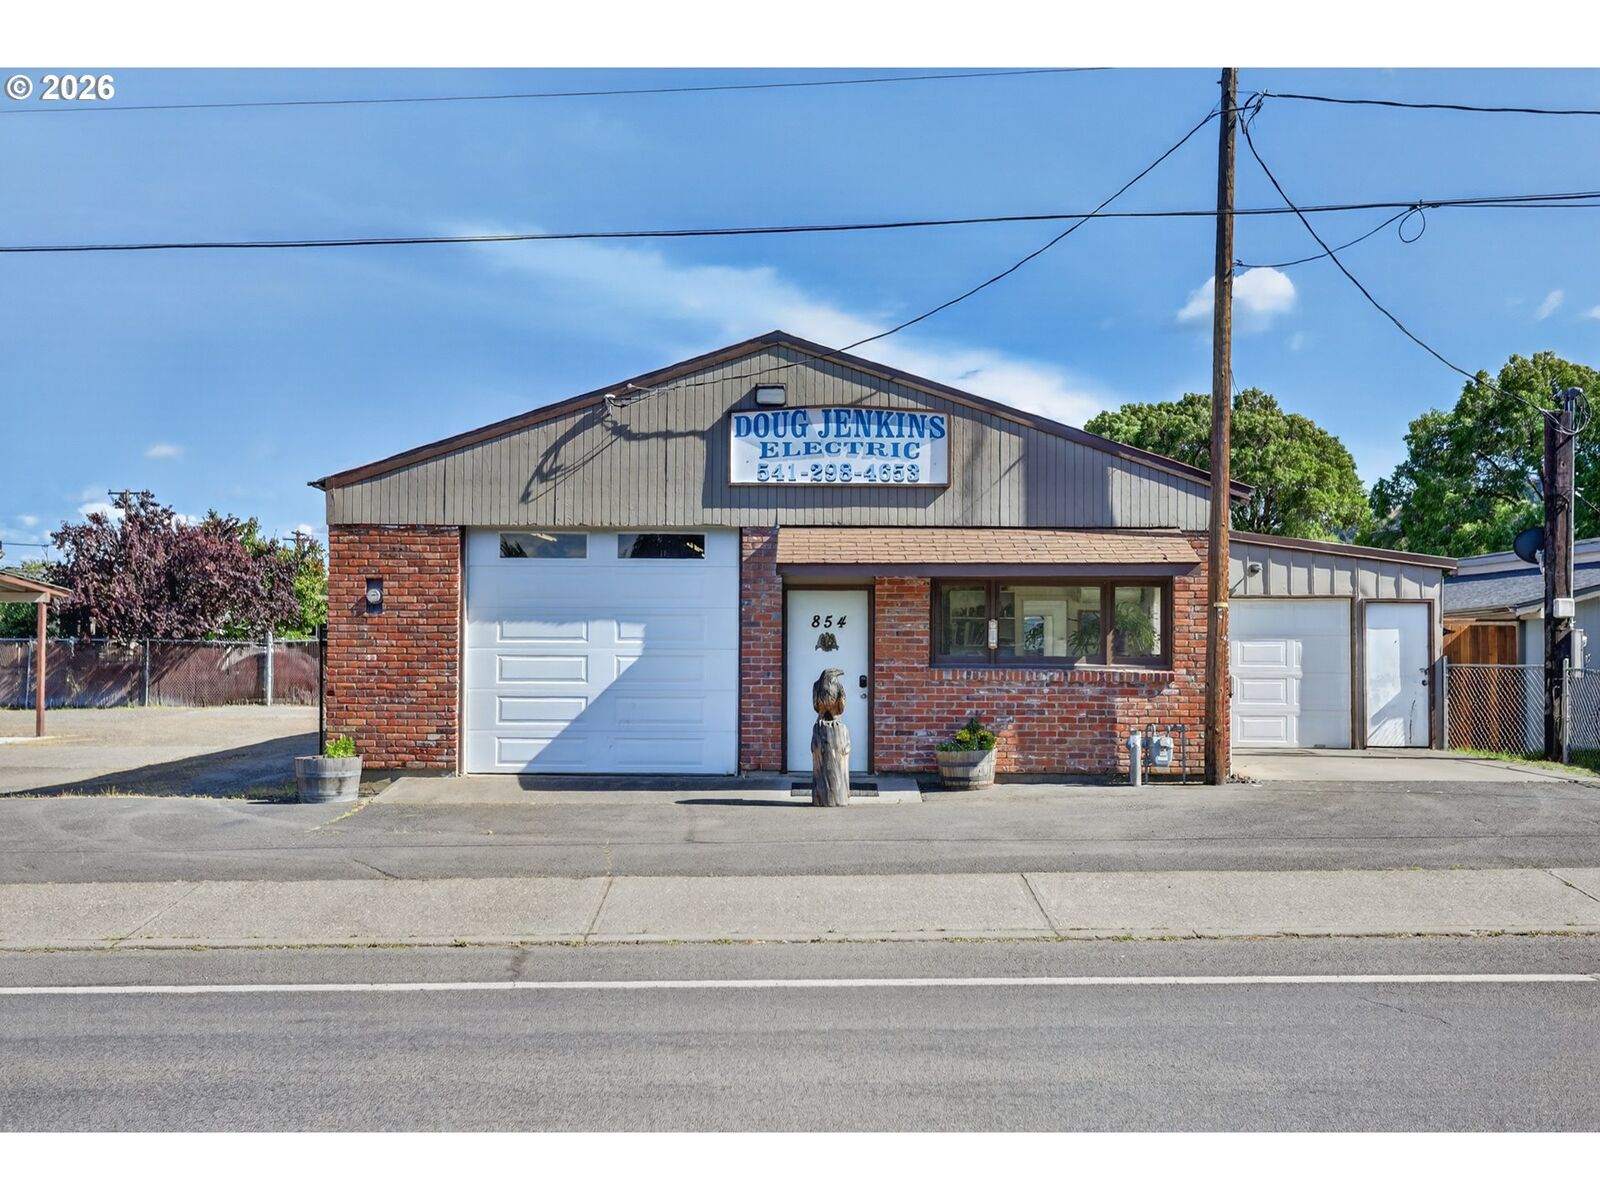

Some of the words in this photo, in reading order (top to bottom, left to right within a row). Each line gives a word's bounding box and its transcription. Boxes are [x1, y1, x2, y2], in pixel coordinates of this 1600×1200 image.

[734, 409, 807, 438] DOUG
[818, 408, 946, 439] JENKINS
[759, 441, 920, 459] ELECTRIC
[757, 463, 920, 482] 541-298-4653
[811, 615, 847, 628] 854
